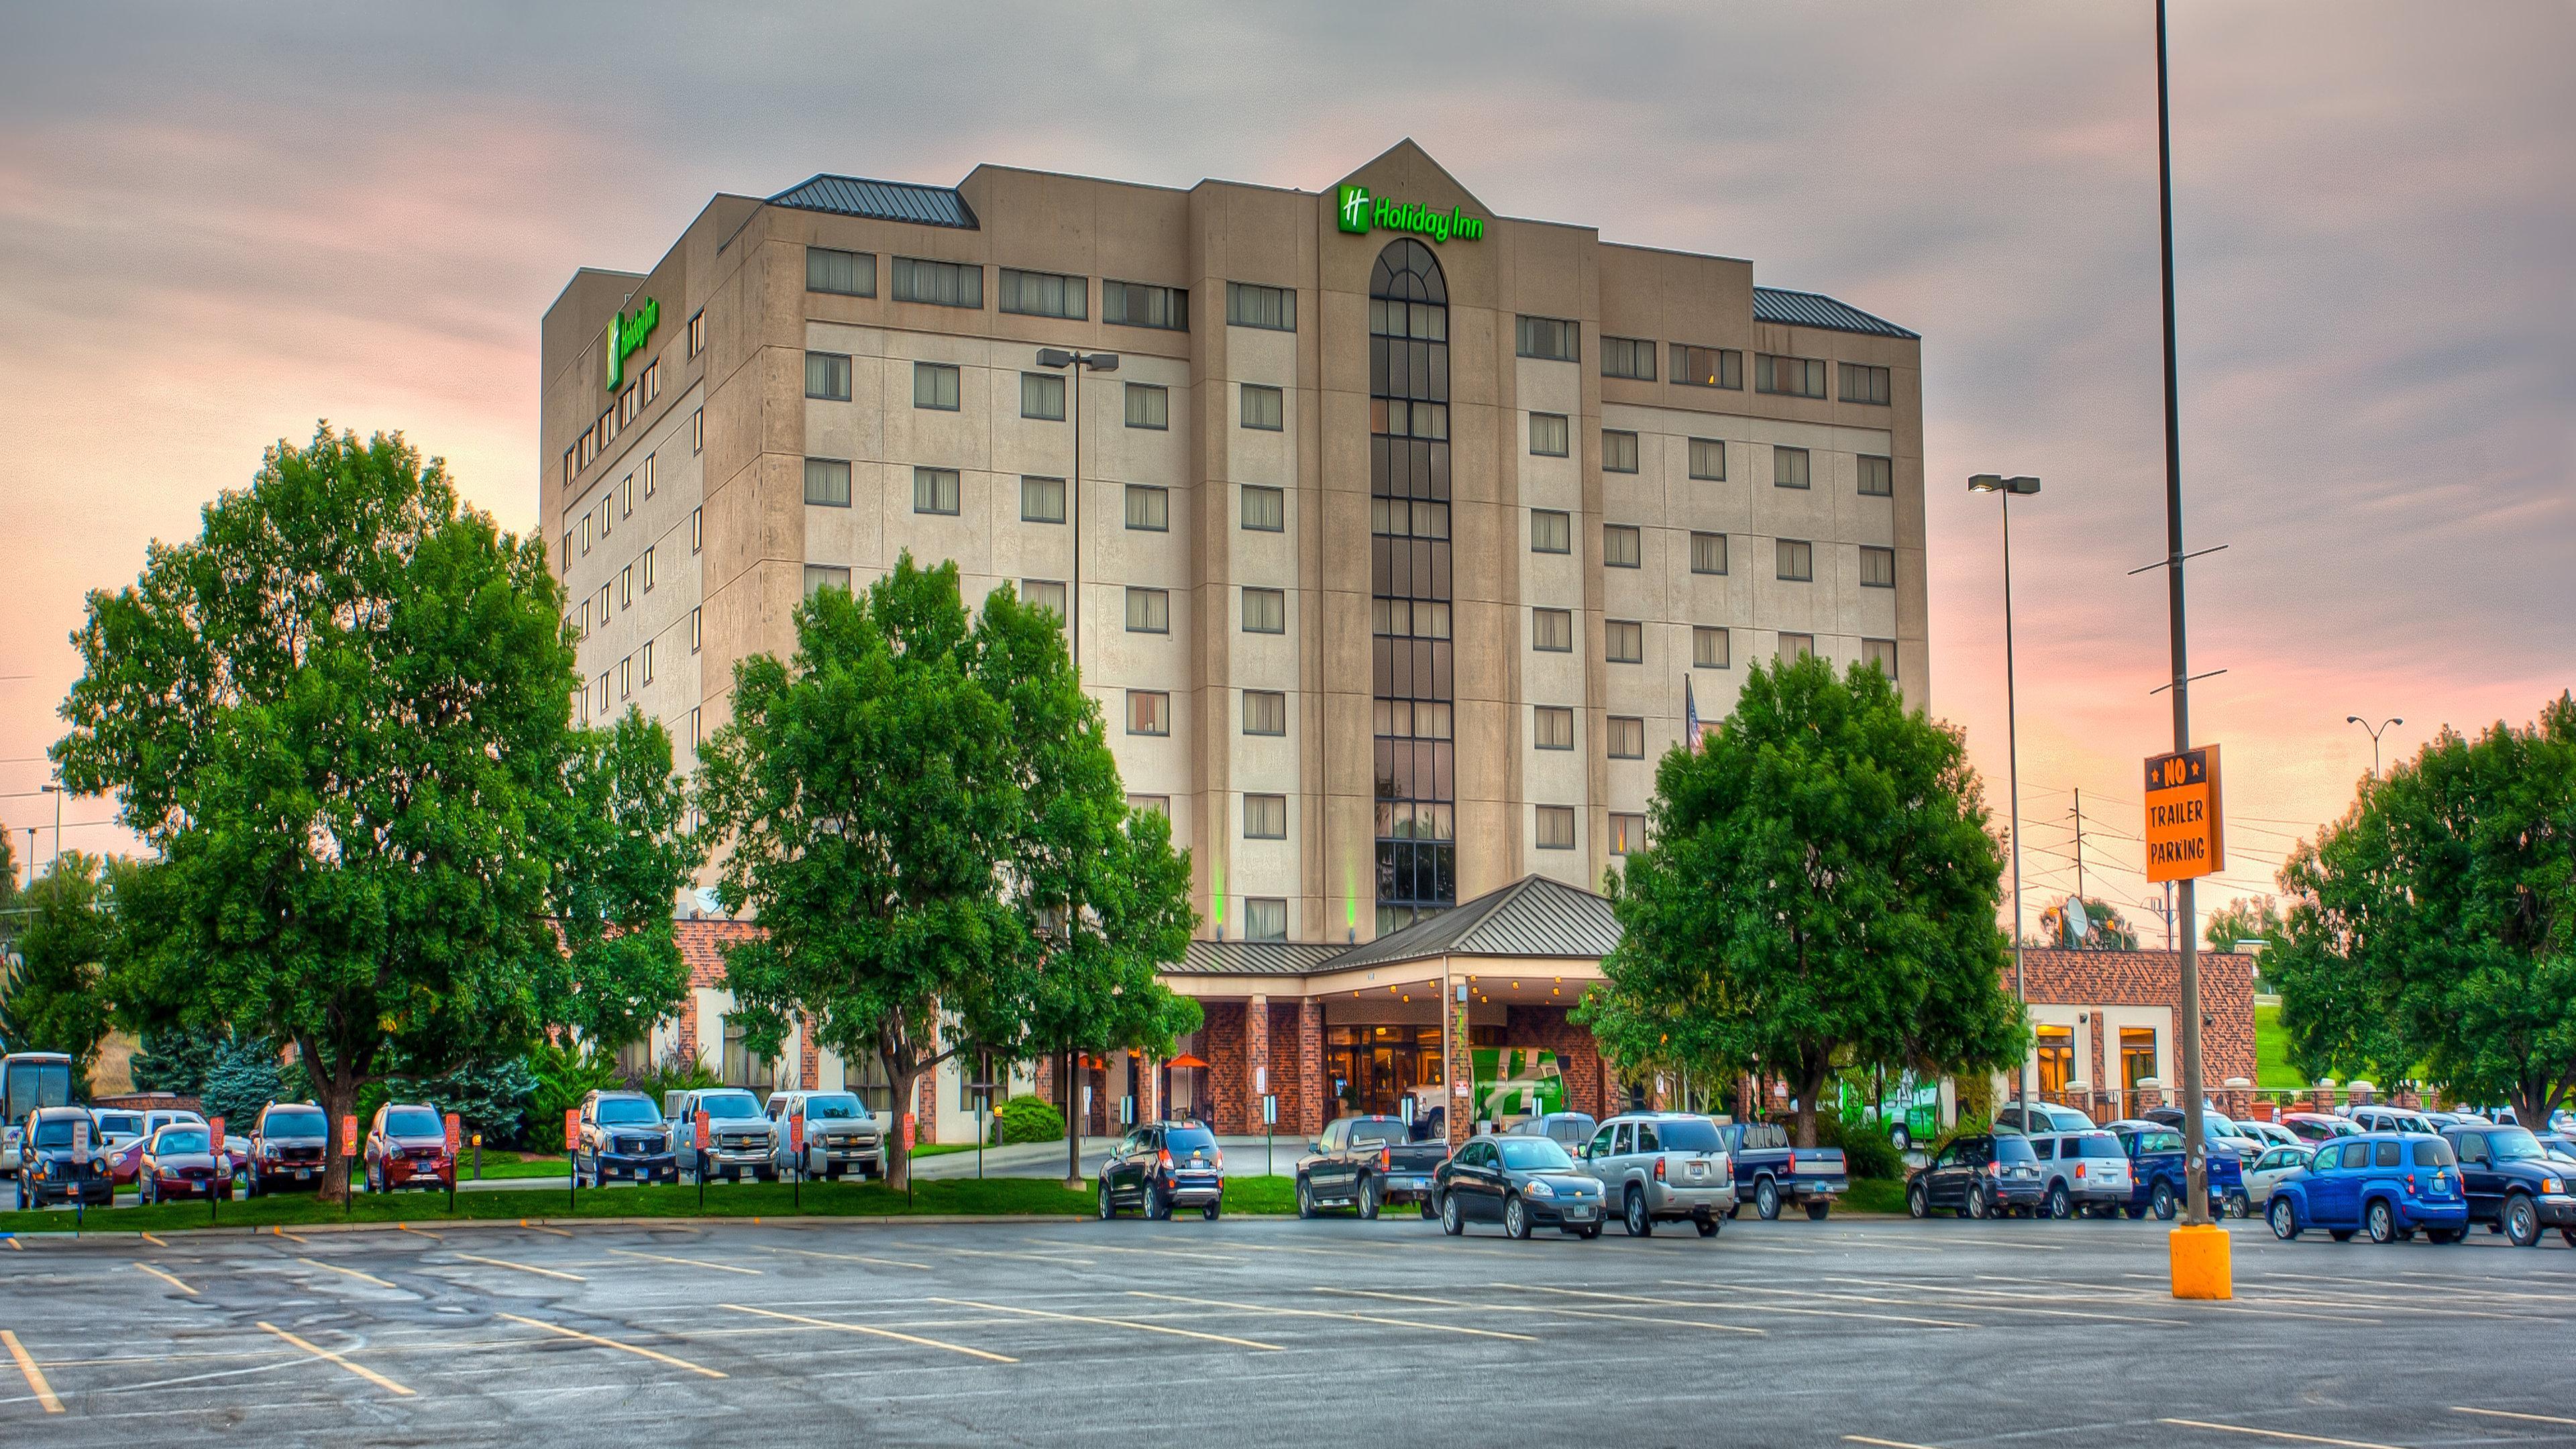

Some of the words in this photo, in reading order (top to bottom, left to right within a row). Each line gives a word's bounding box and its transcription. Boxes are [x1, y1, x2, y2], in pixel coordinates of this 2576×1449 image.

[1373, 196, 1449, 243] Holiday
[1452, 205, 1484, 240] Inn
[621, 307, 646, 360] Holiday
[645, 295, 656, 333] Inn
[2163, 757, 2186, 786] NO
[2150, 799, 2203, 828] TRAILER
[2151, 837, 2204, 865] PARKING
